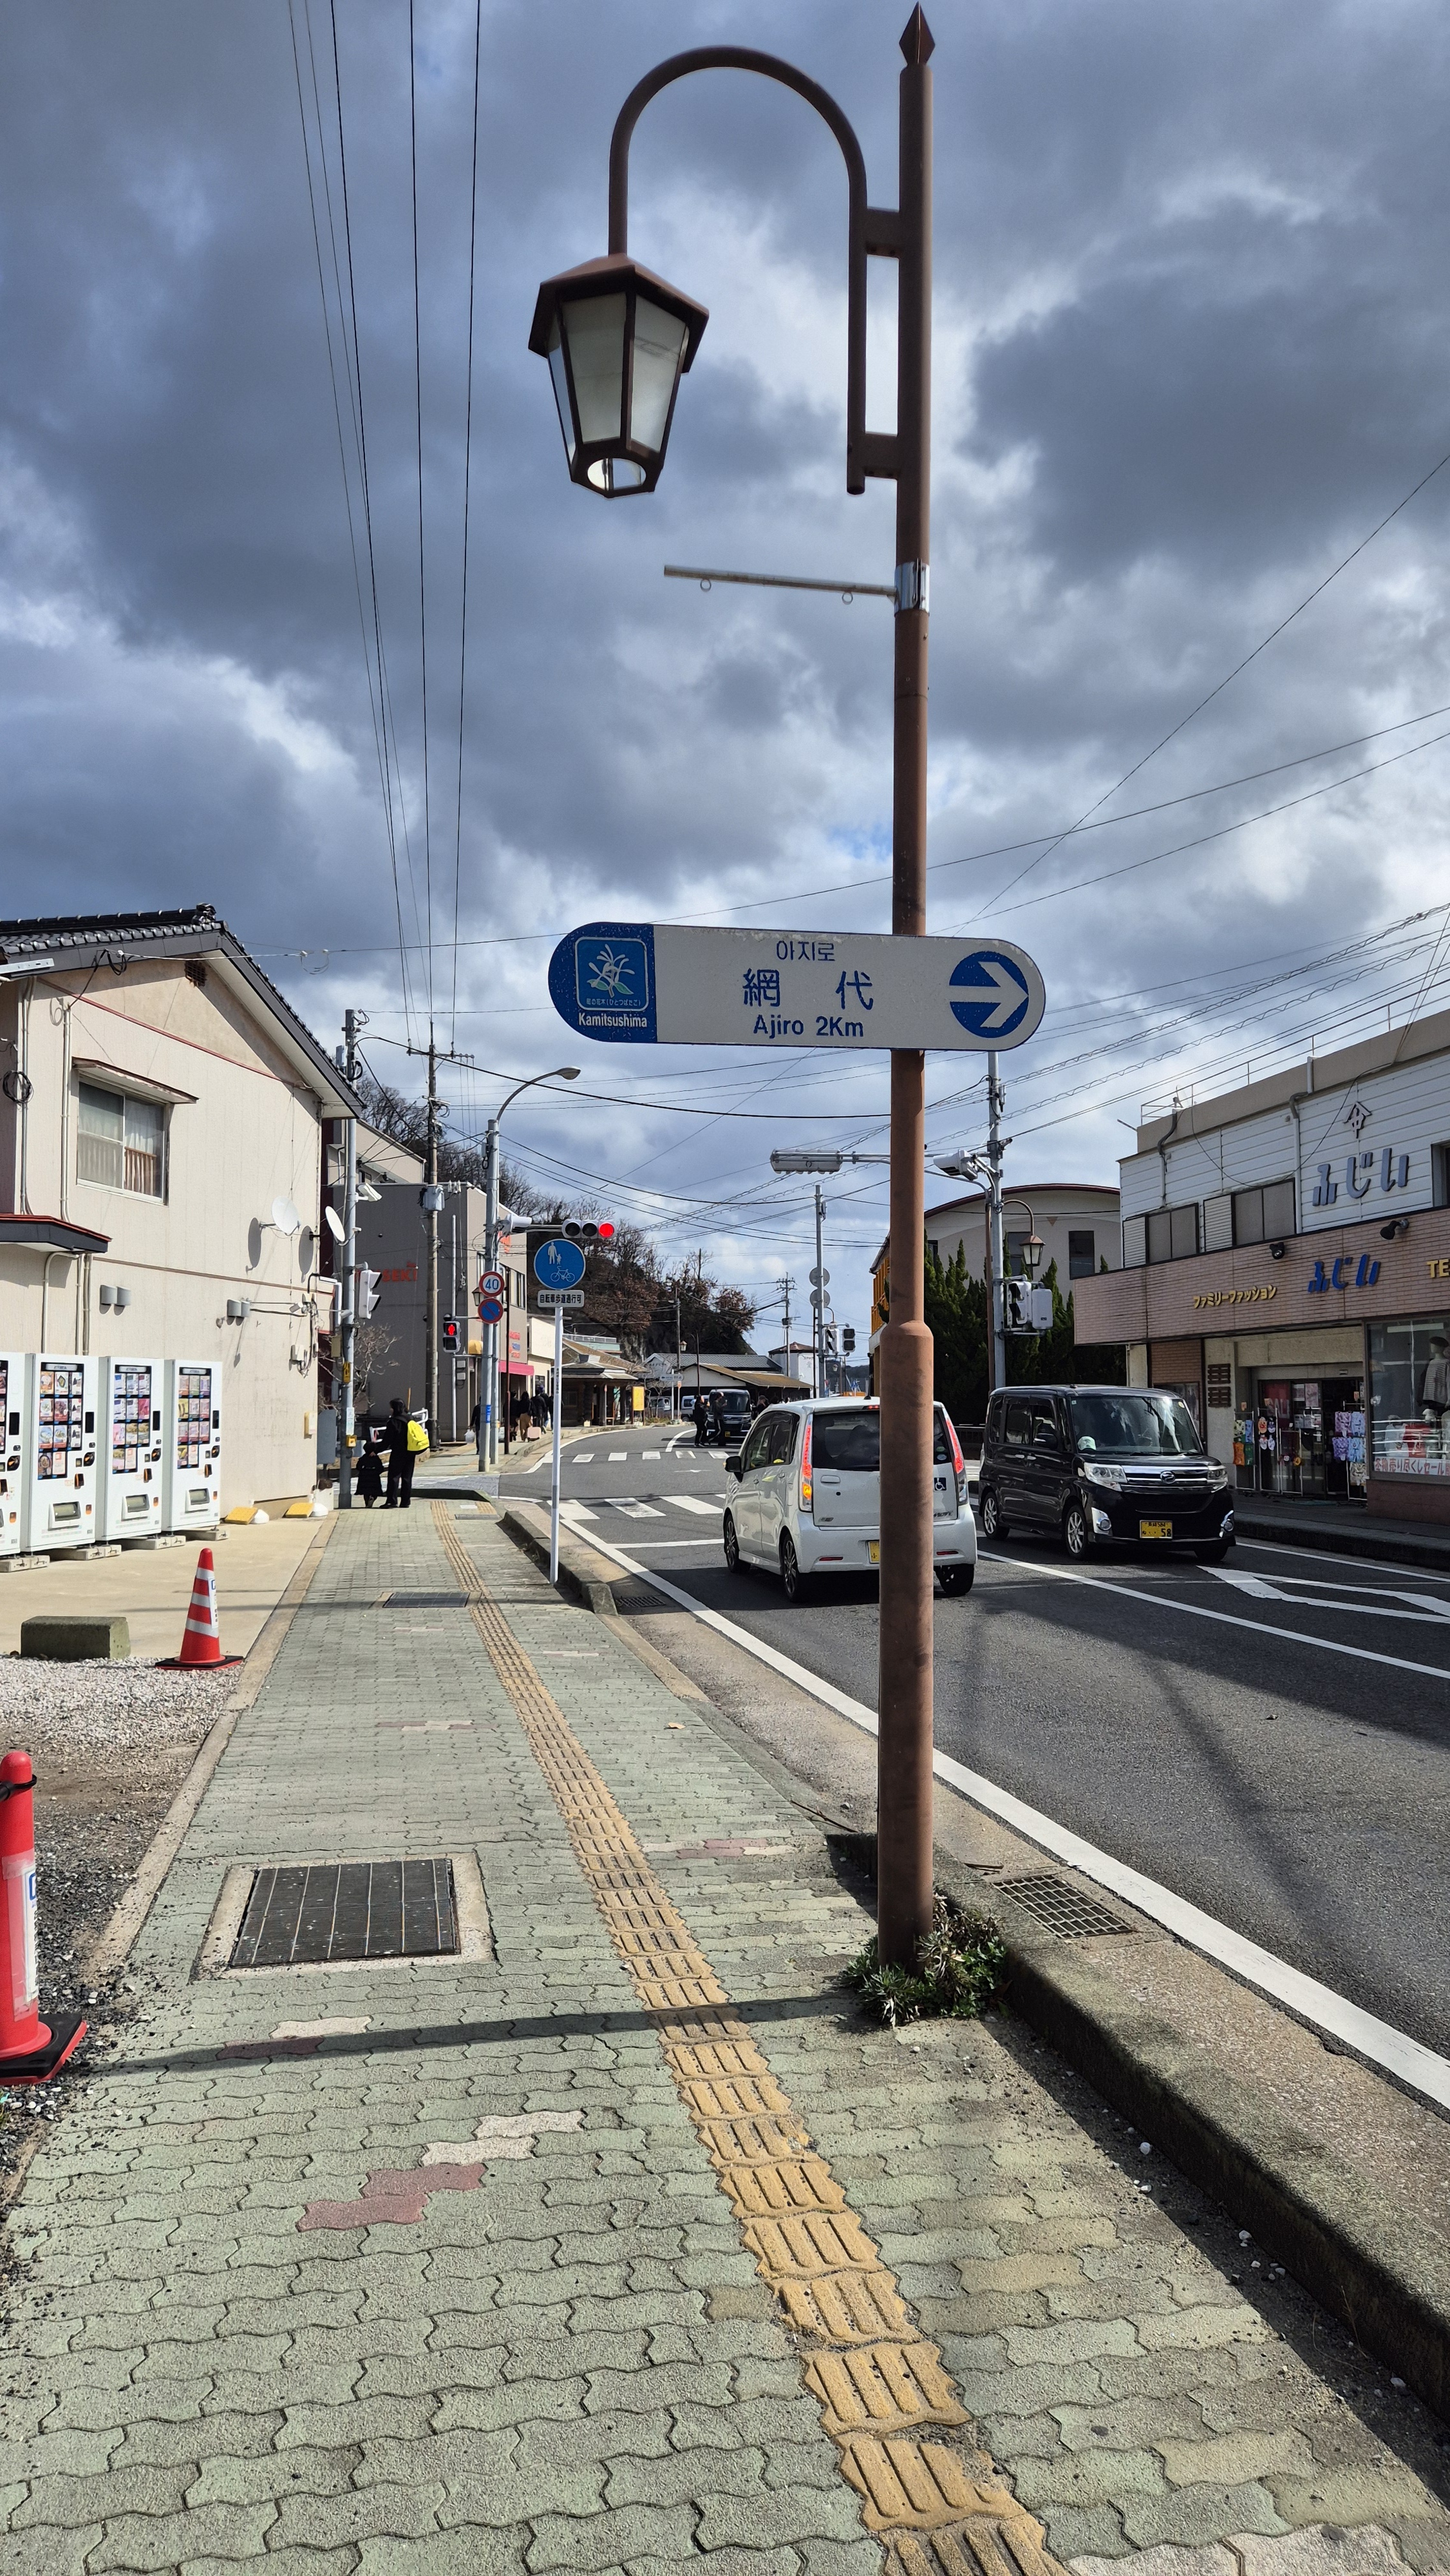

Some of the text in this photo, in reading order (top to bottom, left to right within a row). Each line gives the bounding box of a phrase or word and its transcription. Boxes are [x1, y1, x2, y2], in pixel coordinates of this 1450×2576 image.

[776, 940, 836, 961] 아지로
[742, 968, 874, 1010] 網代
[578, 1012, 648, 1028] Kamitsushima
[753, 1014, 863, 1039] Ajiro 2Km
[1312, 1148, 1409, 1206] ふじい
[485, 1278, 499, 1290] 40
[1307, 1253, 1381, 1293] ふじい
[540, 1294, 582, 1303] 自転車歩道通行可
[1193, 1284, 1277, 1309] ファミリーファッション
